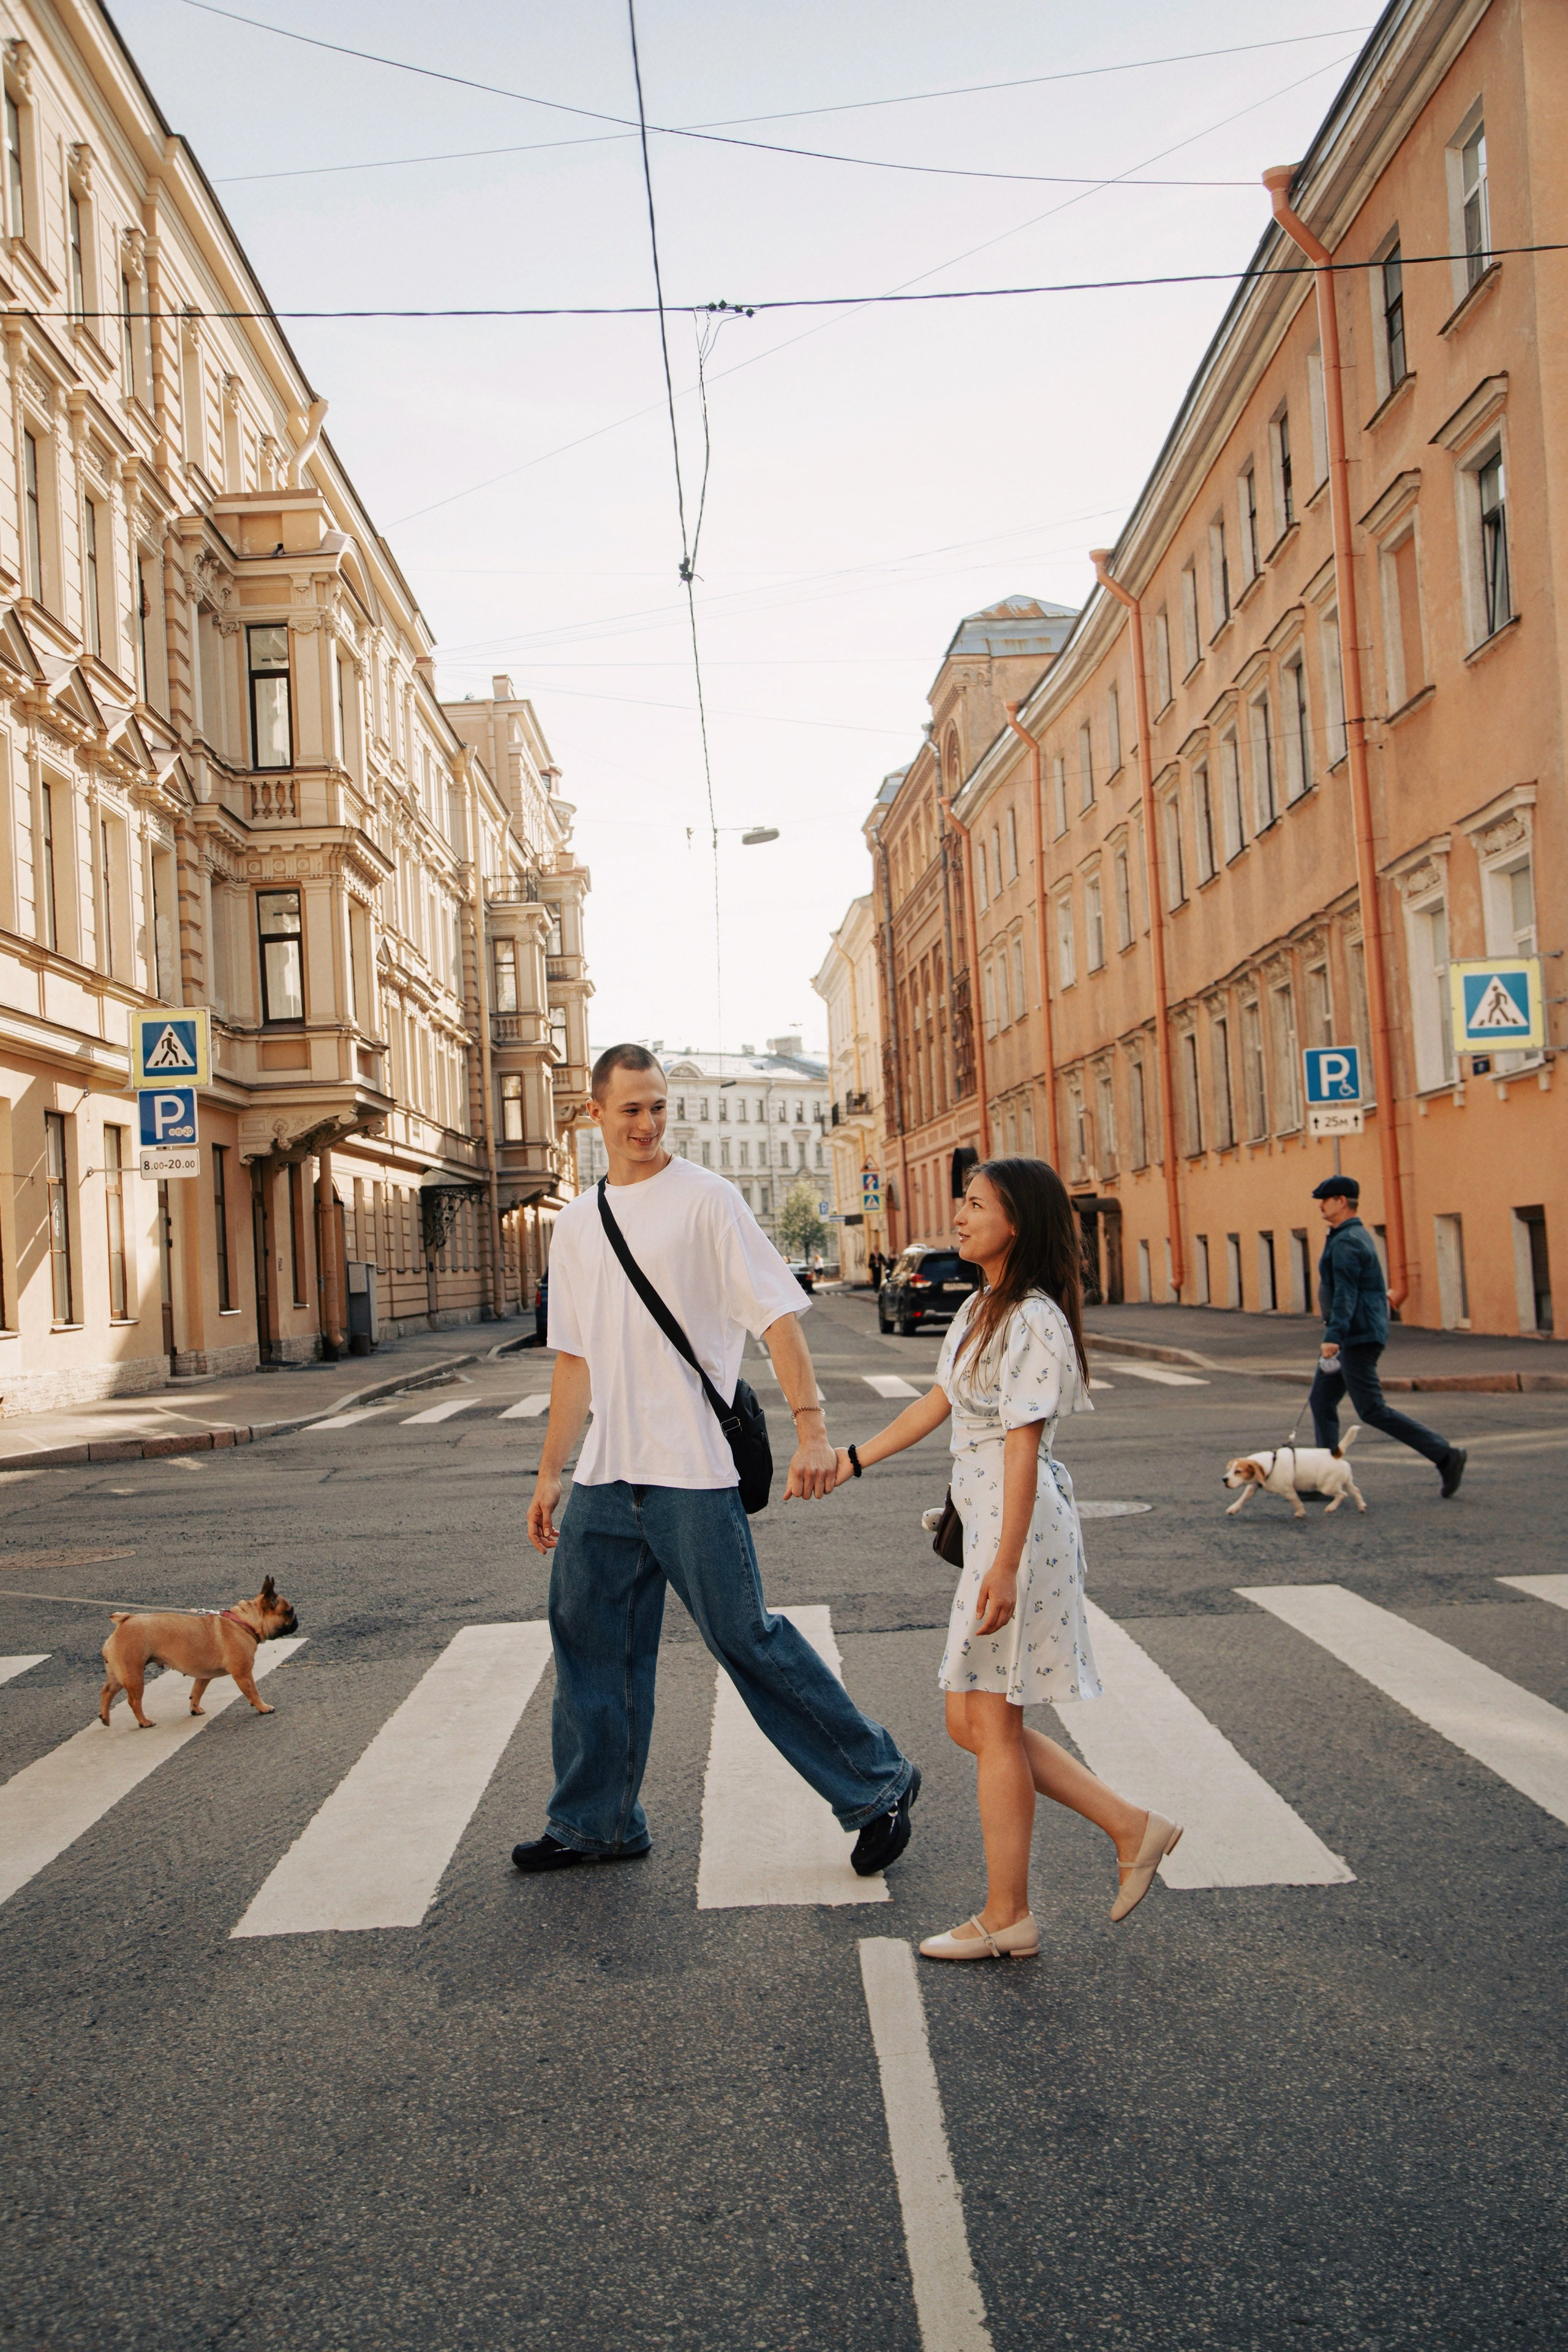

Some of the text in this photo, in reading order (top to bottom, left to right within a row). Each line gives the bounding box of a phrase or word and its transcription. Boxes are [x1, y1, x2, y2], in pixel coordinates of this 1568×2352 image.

[1319, 1054, 1350, 1097] P
[154, 1095, 185, 1139] P
[144, 1158, 195, 1170] 8.00-20.00
